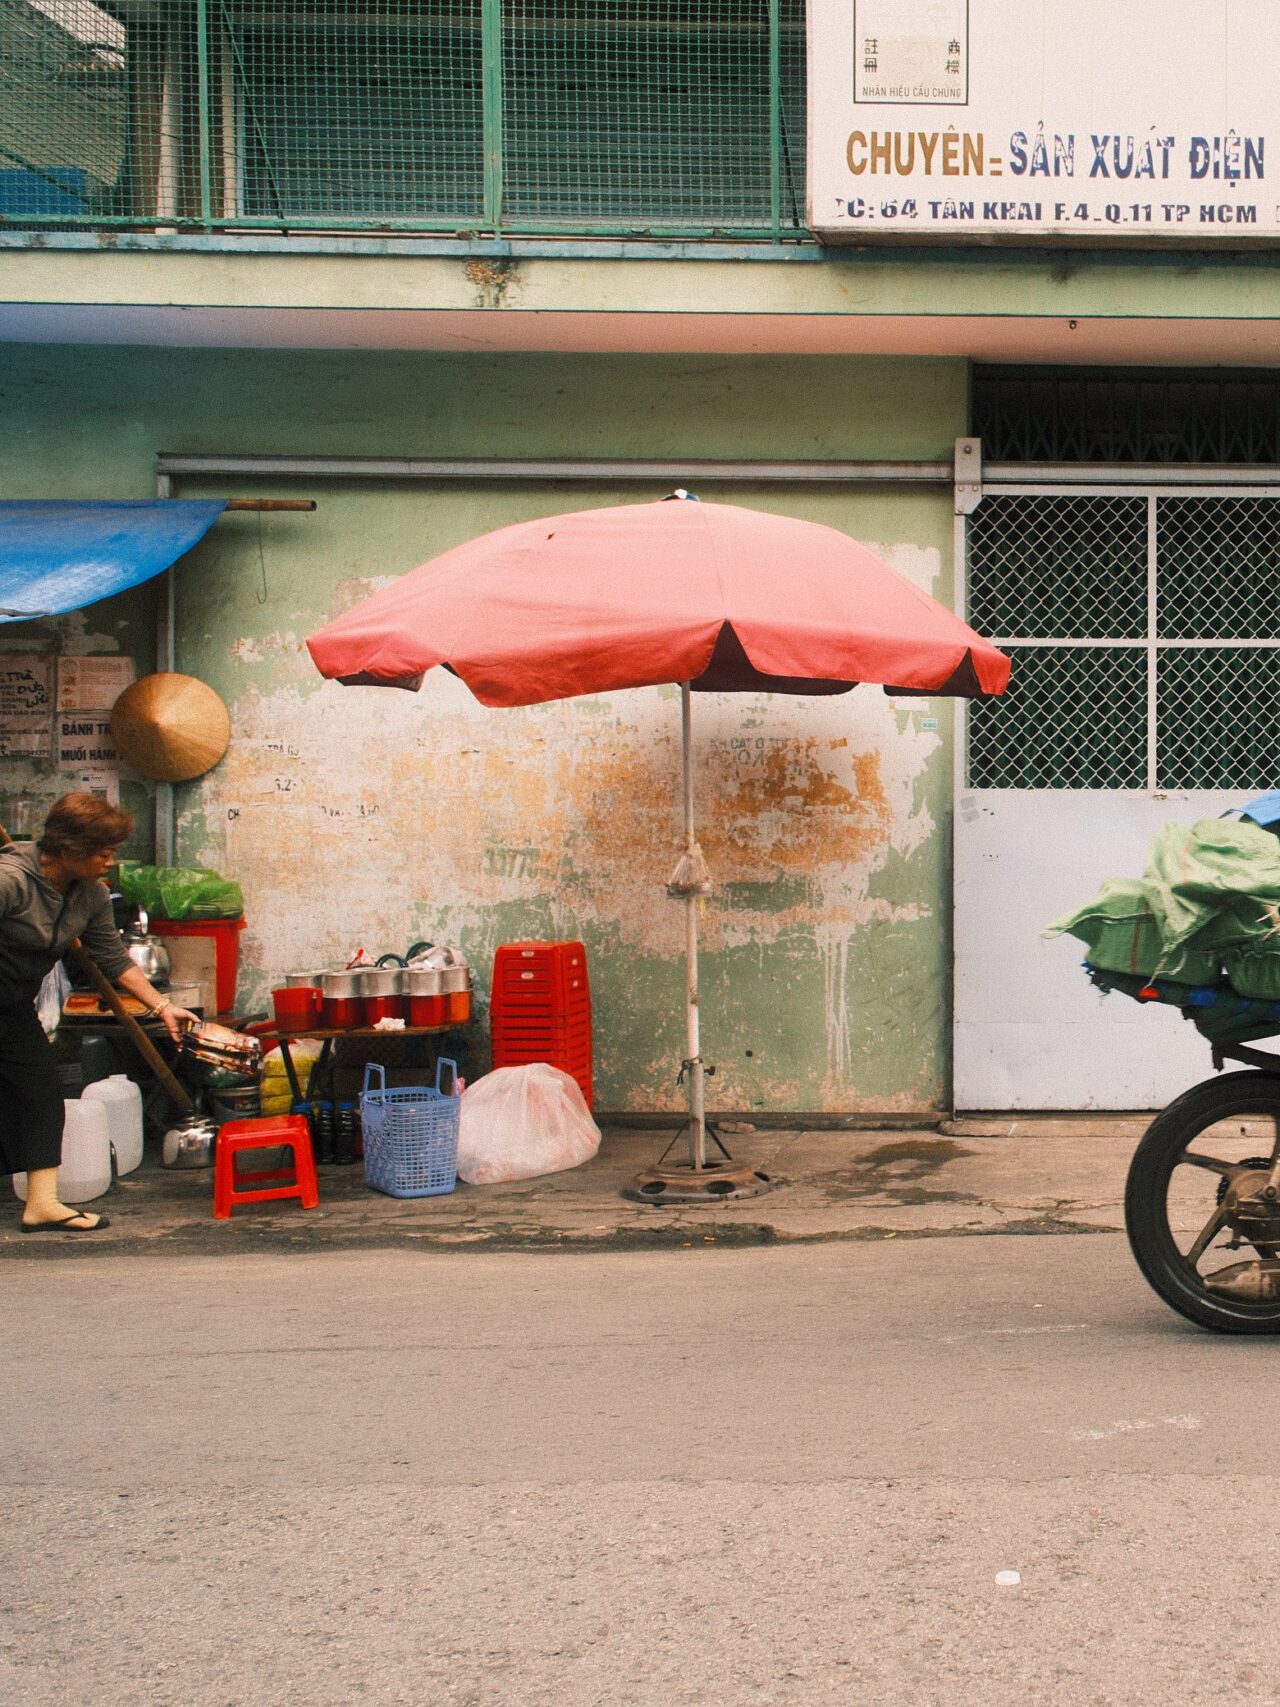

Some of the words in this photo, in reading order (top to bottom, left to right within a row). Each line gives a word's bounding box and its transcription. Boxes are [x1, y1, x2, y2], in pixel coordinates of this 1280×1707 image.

[1009, 120, 1075, 177] SẢN
[1189, 128, 1265, 188] ĐIỆN
[927, 197, 975, 219] TÂN
[983, 201, 1042, 221] KHAI
[1161, 204, 1191, 222] TP
[1199, 204, 1257, 223] HCM
